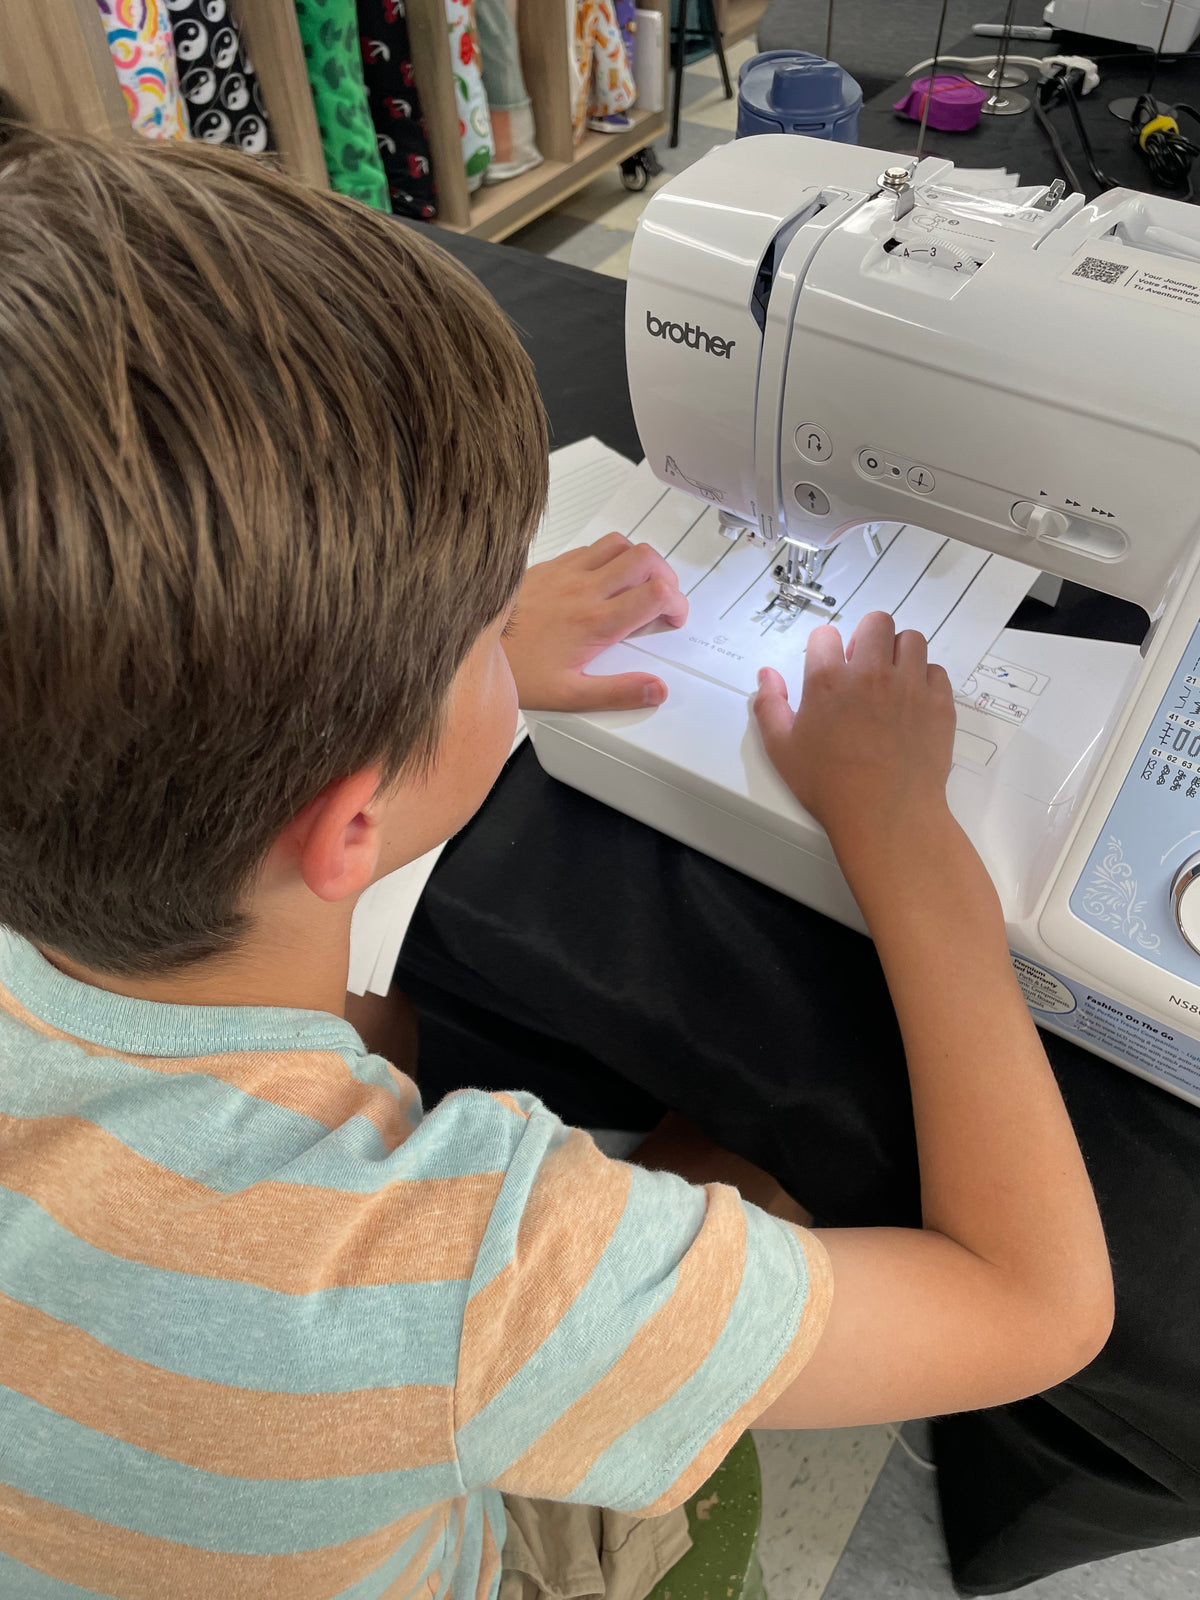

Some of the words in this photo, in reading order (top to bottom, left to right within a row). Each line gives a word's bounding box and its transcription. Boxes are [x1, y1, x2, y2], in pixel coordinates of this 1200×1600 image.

[903, 248, 910, 258] 4
[930, 247, 937, 257] 3
[953, 261, 963, 271] 2
[1138, 278, 1160, 287] Votre
[1161, 285, 1200, 297] Aventure
[1143, 272, 1163, 281] Your
[1163, 278, 1198, 290] Journey
[1145, 288, 1183, 301] Aventura
[646, 310, 736, 360] brother
[1185, 676, 1197, 685] 21
[1168, 713, 1179, 722] 41
[1184, 719, 1195, 728] 42
[1151, 748, 1162, 757] 61
[1166, 754, 1178, 764] 62
[1181, 760, 1193, 770] 63
[1015, 958, 1045, 977] Premium
[1027, 970, 1056, 989] Warranty
[1169, 995, 1200, 1016] NS8
[1087, 995, 1123, 1016] Fashion
[1125, 1014, 1139, 1023] On
[1141, 1022, 1158, 1033] The
[1160, 1031, 1174, 1040] Go
[1097, 1009, 1118, 1021] Perfect
[1140, 1030, 1178, 1051] Companion
